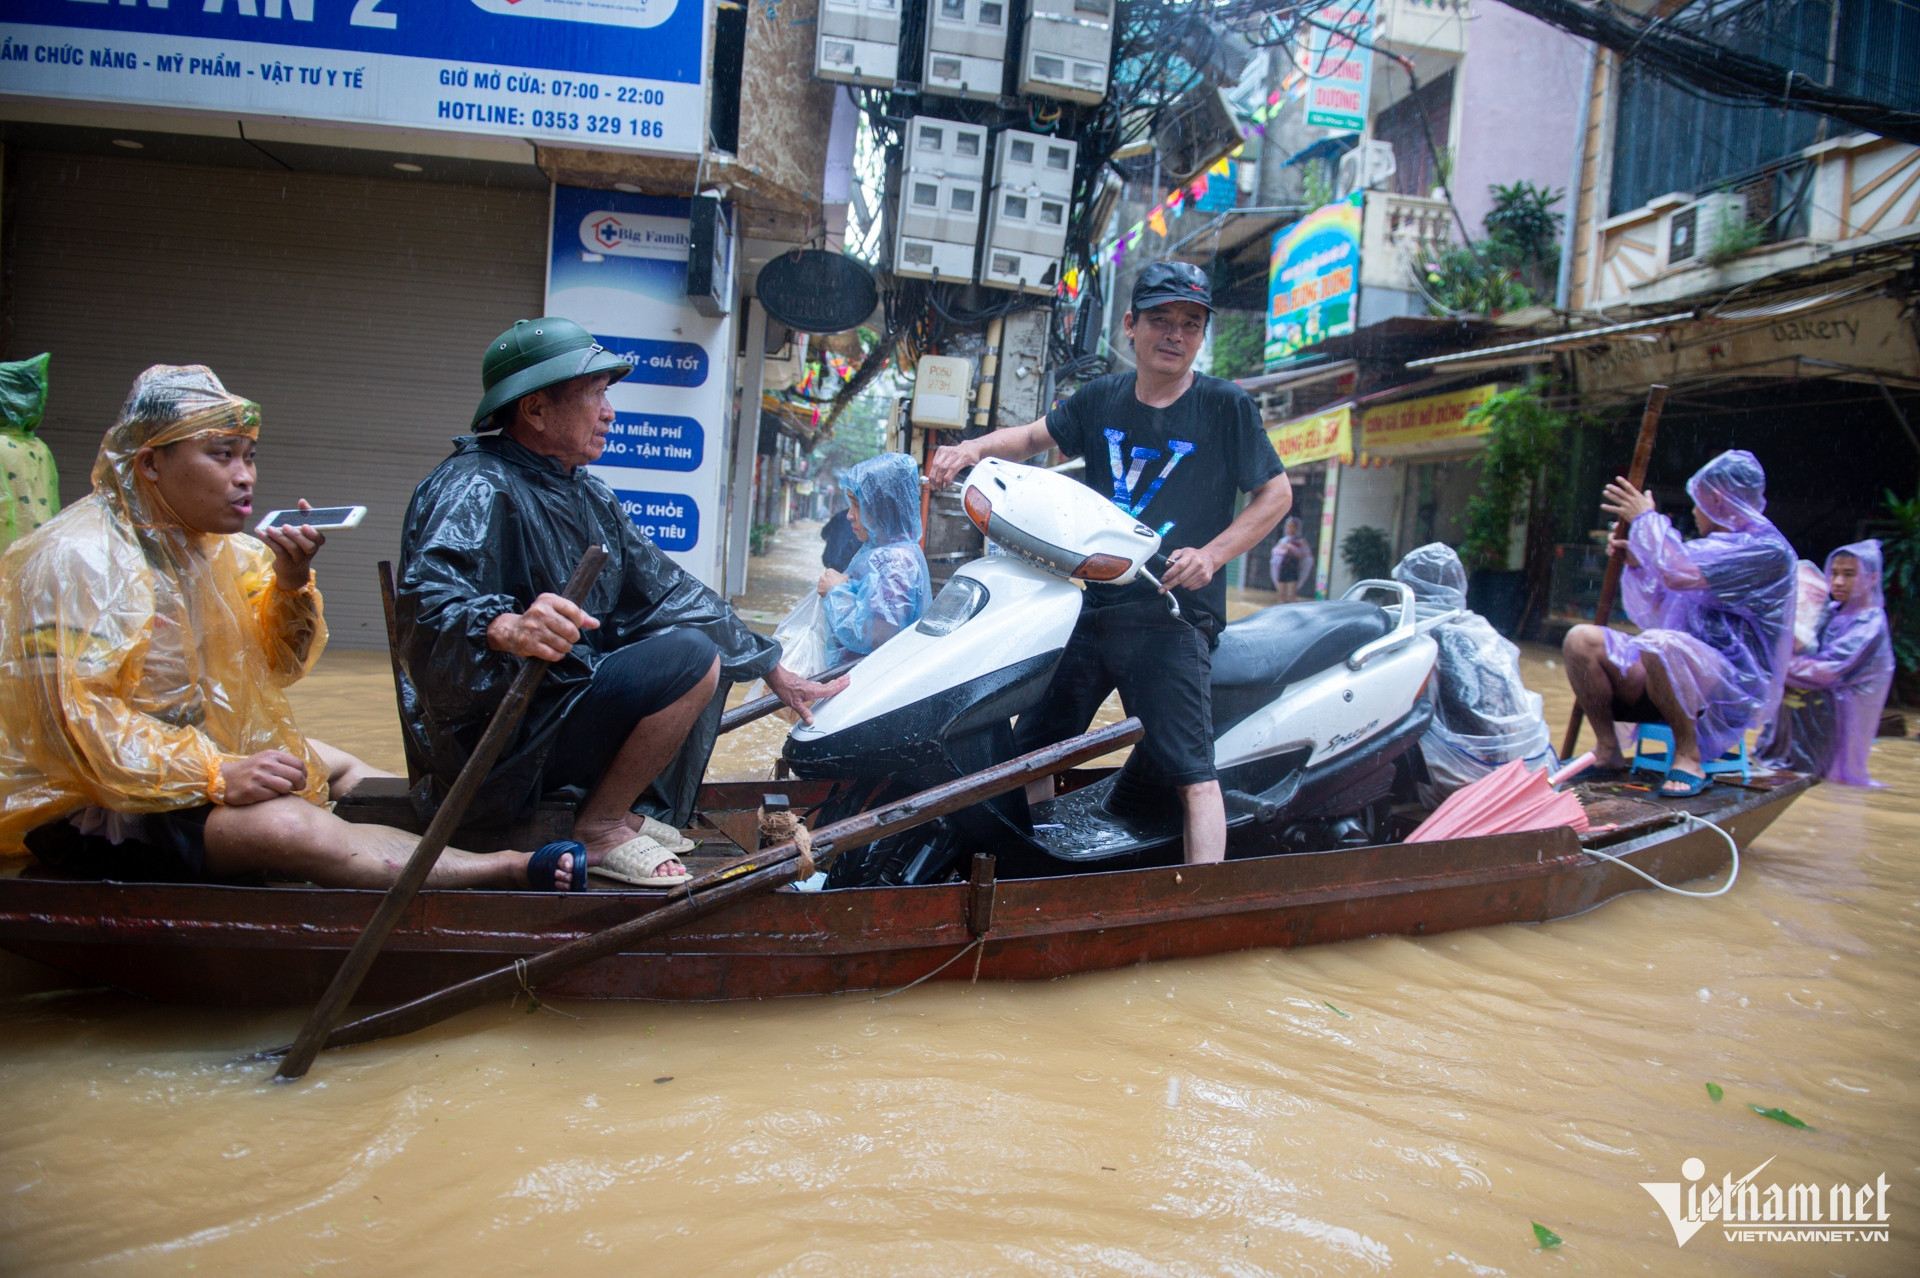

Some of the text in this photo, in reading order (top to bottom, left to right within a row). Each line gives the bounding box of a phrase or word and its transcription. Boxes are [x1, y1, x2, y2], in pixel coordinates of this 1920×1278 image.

[34, 43, 84, 66] CHỨC
[90, 47, 137, 70] NĂNG
[156, 52, 184, 74] MỸ
[189, 52, 241, 78] PHẨM
[260, 60, 294, 86] VẬT
[299, 66, 322, 85] TƯ
[326, 69, 337, 87] Y
[343, 66, 366, 89] TẾ
[439, 66, 469, 88] GIỜ
[473, 69, 502, 91] MỞ
[506, 72, 546, 95] CỬA:
[551, 80, 599, 100] 07:00
[617, 86, 665, 106] 22:00
[438, 101, 664, 139] HOTLINE: 0353 329 186
[618, 227, 641, 243] Big
[650, 354, 673, 369] GIÁ
[676, 354, 699, 371] TỐT
[627, 421, 658, 437] MIỄN
[661, 425, 682, 440] PHÍ
[636, 442, 661, 459] TẬN
[663, 442, 693, 459] TÌNH
[620, 499, 684, 518] ỨC KHỎE
[658, 524, 686, 539] TIÊU
